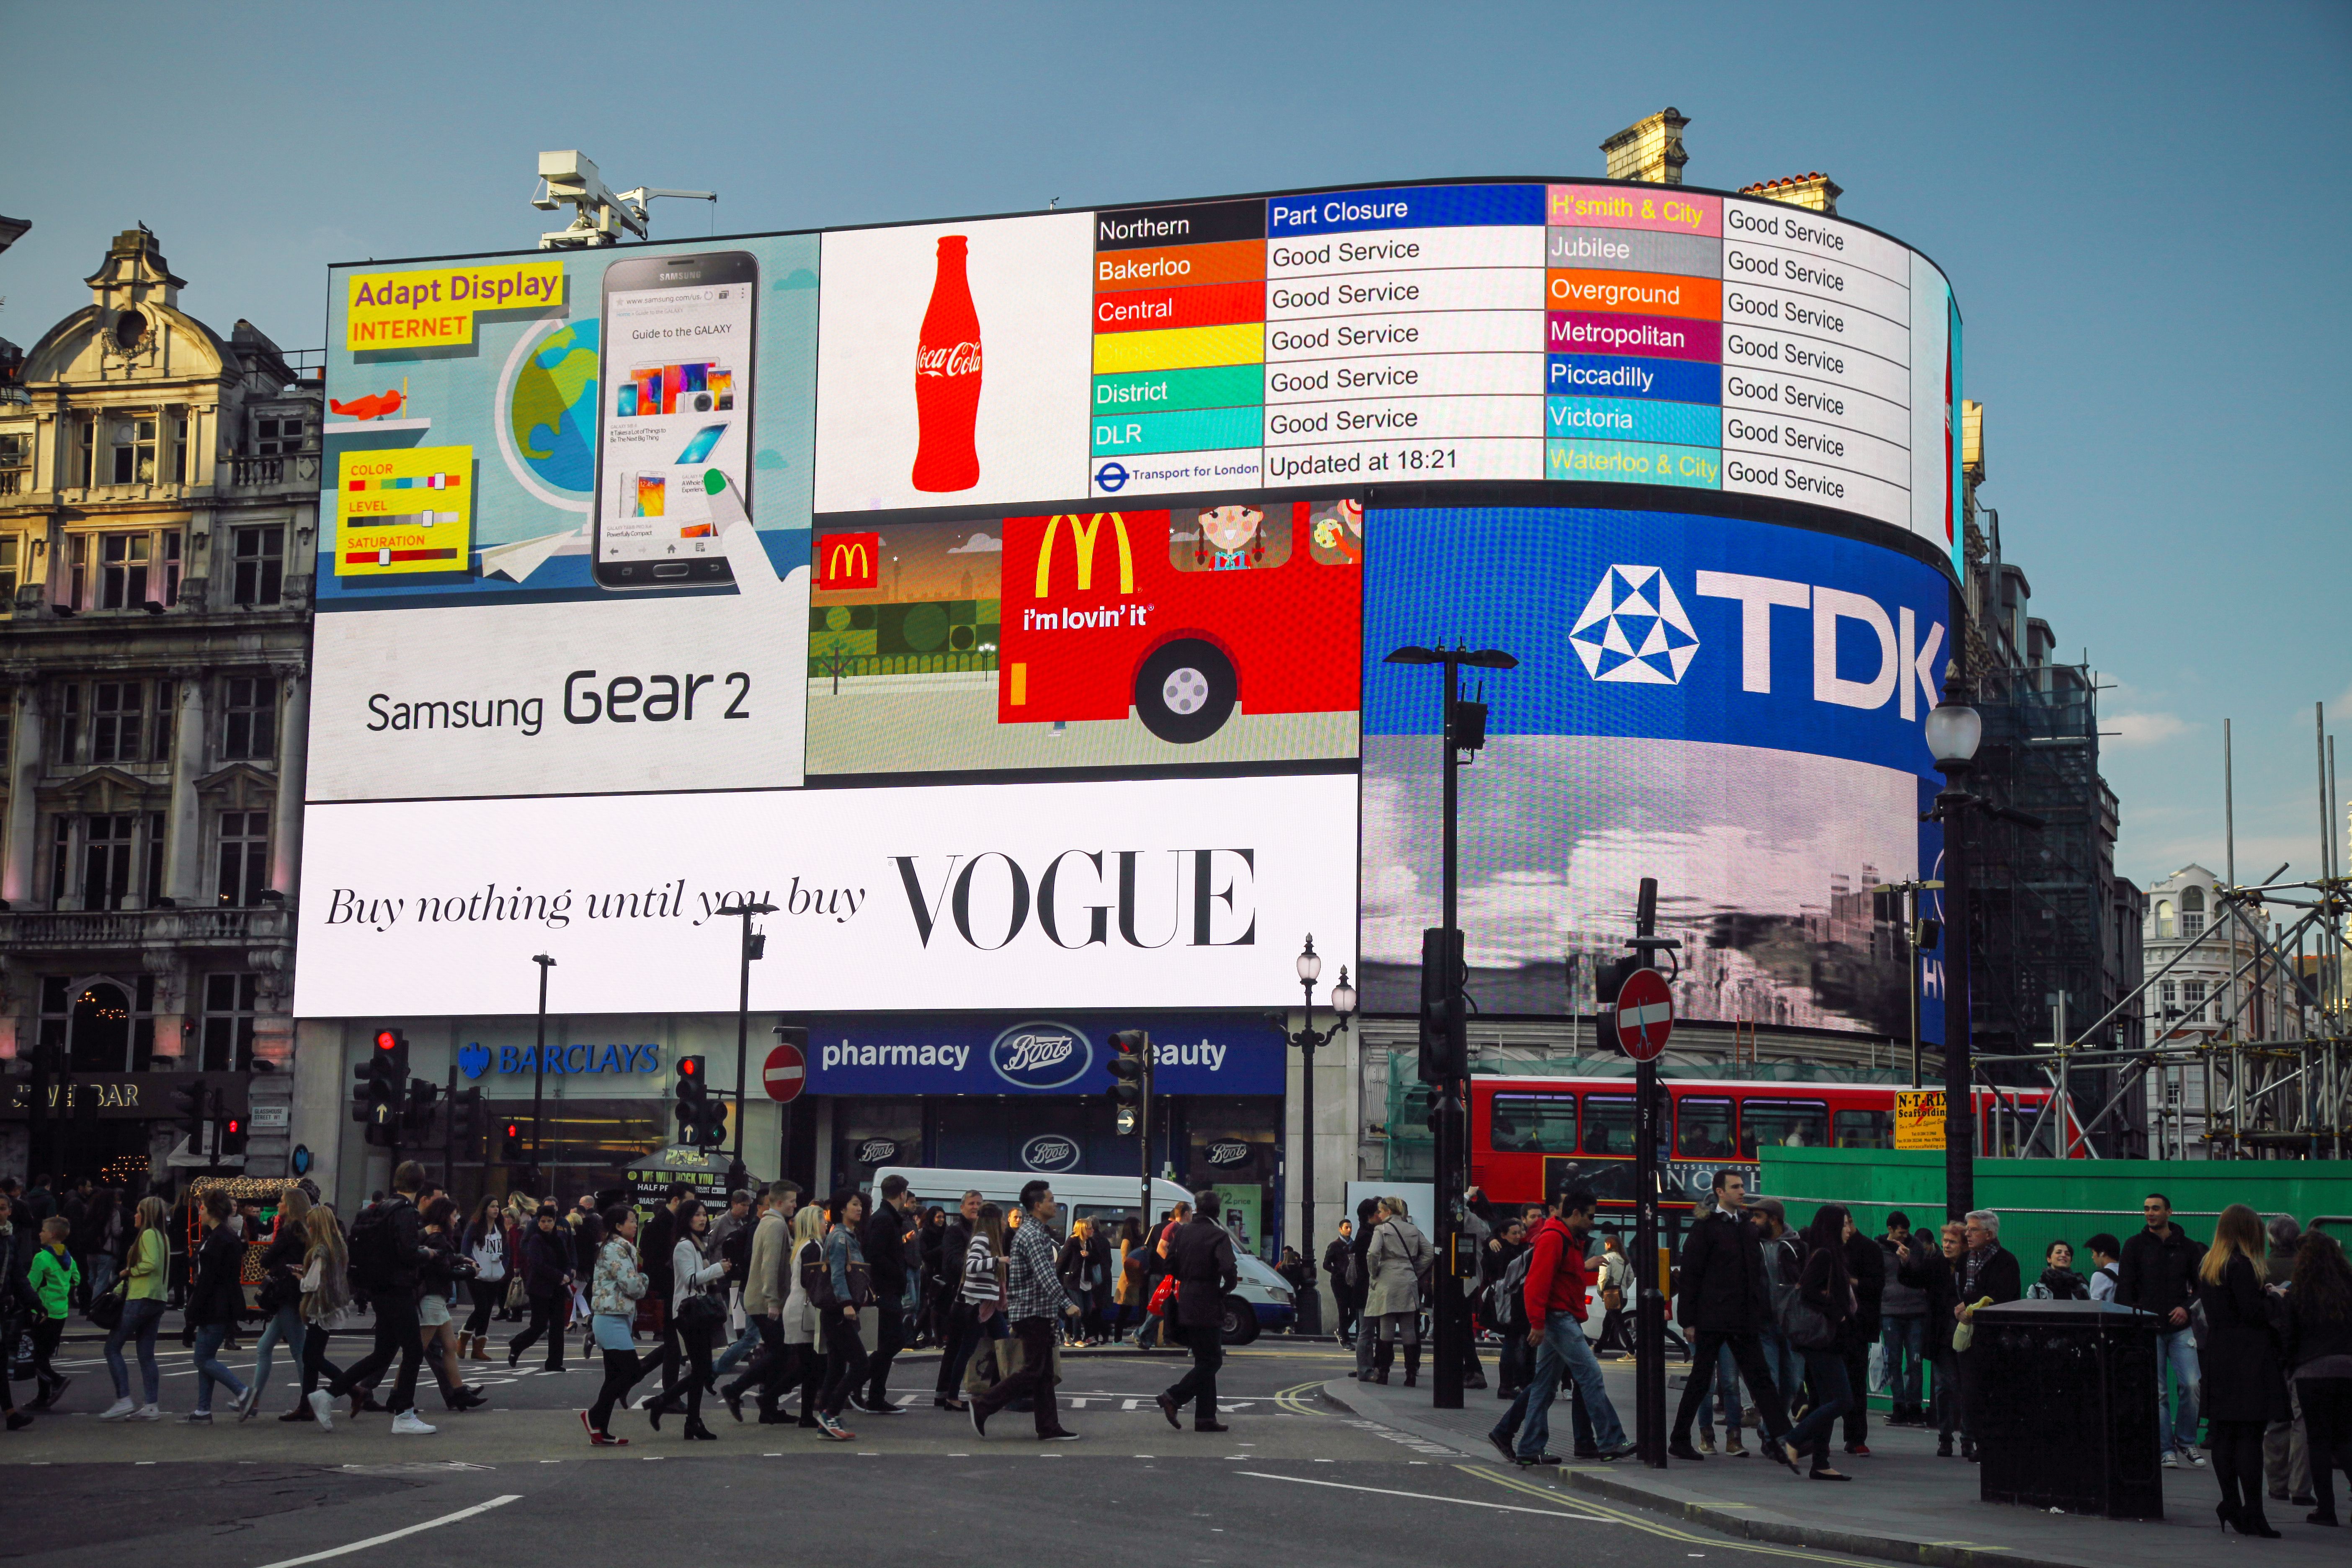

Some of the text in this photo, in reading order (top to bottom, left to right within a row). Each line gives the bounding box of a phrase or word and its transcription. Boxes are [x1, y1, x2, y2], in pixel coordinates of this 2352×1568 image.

[1274, 201, 1408, 226] Part Closure
[1553, 194, 1703, 228] H'smith & City
[1101, 219, 1189, 240] Northern
[1728, 210, 1844, 251] Good Service
[1273, 240, 1419, 267] Good Service
[1551, 236, 1630, 259] Jubilee
[660, 271, 701, 281] SAMSUNG
[1099, 257, 1190, 280] Bakerloo
[1728, 250, 1844, 291] Good Service
[355, 271, 558, 310] Adapt Display
[1272, 282, 1419, 308] Good Service
[1551, 279, 1679, 305] Overground
[1099, 298, 1172, 321] Central
[1728, 292, 1844, 333] Good Service
[353, 316, 467, 341] INTERNET
[632, 324, 732, 339] Guide to the GALAXY
[1271, 324, 1418, 351] Good Service
[1551, 320, 1684, 348] Metropolitan
[917, 342, 981, 377] Coca-Cola
[1728, 335, 1844, 374] Good Service
[1271, 366, 1418, 392] Good Service
[1551, 363, 1653, 392] Piccadilly
[1097, 382, 1168, 404] District
[1728, 377, 1844, 415] Good Service
[1271, 408, 1418, 434] Good Service
[1550, 406, 1633, 428] Victoria
[1096, 424, 1142, 445] DLR
[1728, 419, 1844, 457] Good Service
[351, 464, 393, 476] COLOR
[1133, 464, 1259, 480] Transport for London
[1271, 449, 1456, 480] Updated at 18:21
[1550, 449, 1718, 482] Waterloo & City
[1728, 461, 1844, 498] Good Service
[349, 501, 387, 512] LEVEL
[347, 535, 425, 549] SATURATION
[1696, 570, 1945, 722] TDK
[366, 670, 750, 736] Samsung Gear 2
[324, 888, 404, 932] Buy
[416, 883, 572, 929] nothing
[585, 879, 685, 919] until
[788, 876, 865, 923] buy
[887, 848, 1255, 950] VOGUE
[498, 1044, 659, 1074] BARCLAYS
[822, 1034, 1227, 1071] pharmacy Boots eauty
[1898, 1108, 1946, 1118] Scaffoldin
[859, 1139, 895, 1162] Boots
[1030, 1142, 1070, 1165] Boots
[1209, 1142, 1247, 1164] Boots
[642, 1171, 654, 1182] WE
[656, 1171, 673, 1183] WILL
[676, 1172, 696, 1184] ROCK
[699, 1173, 714, 1185] YOU
[1667, 1170, 1761, 1192] NOH
[480, 1239, 502, 1253] INK
